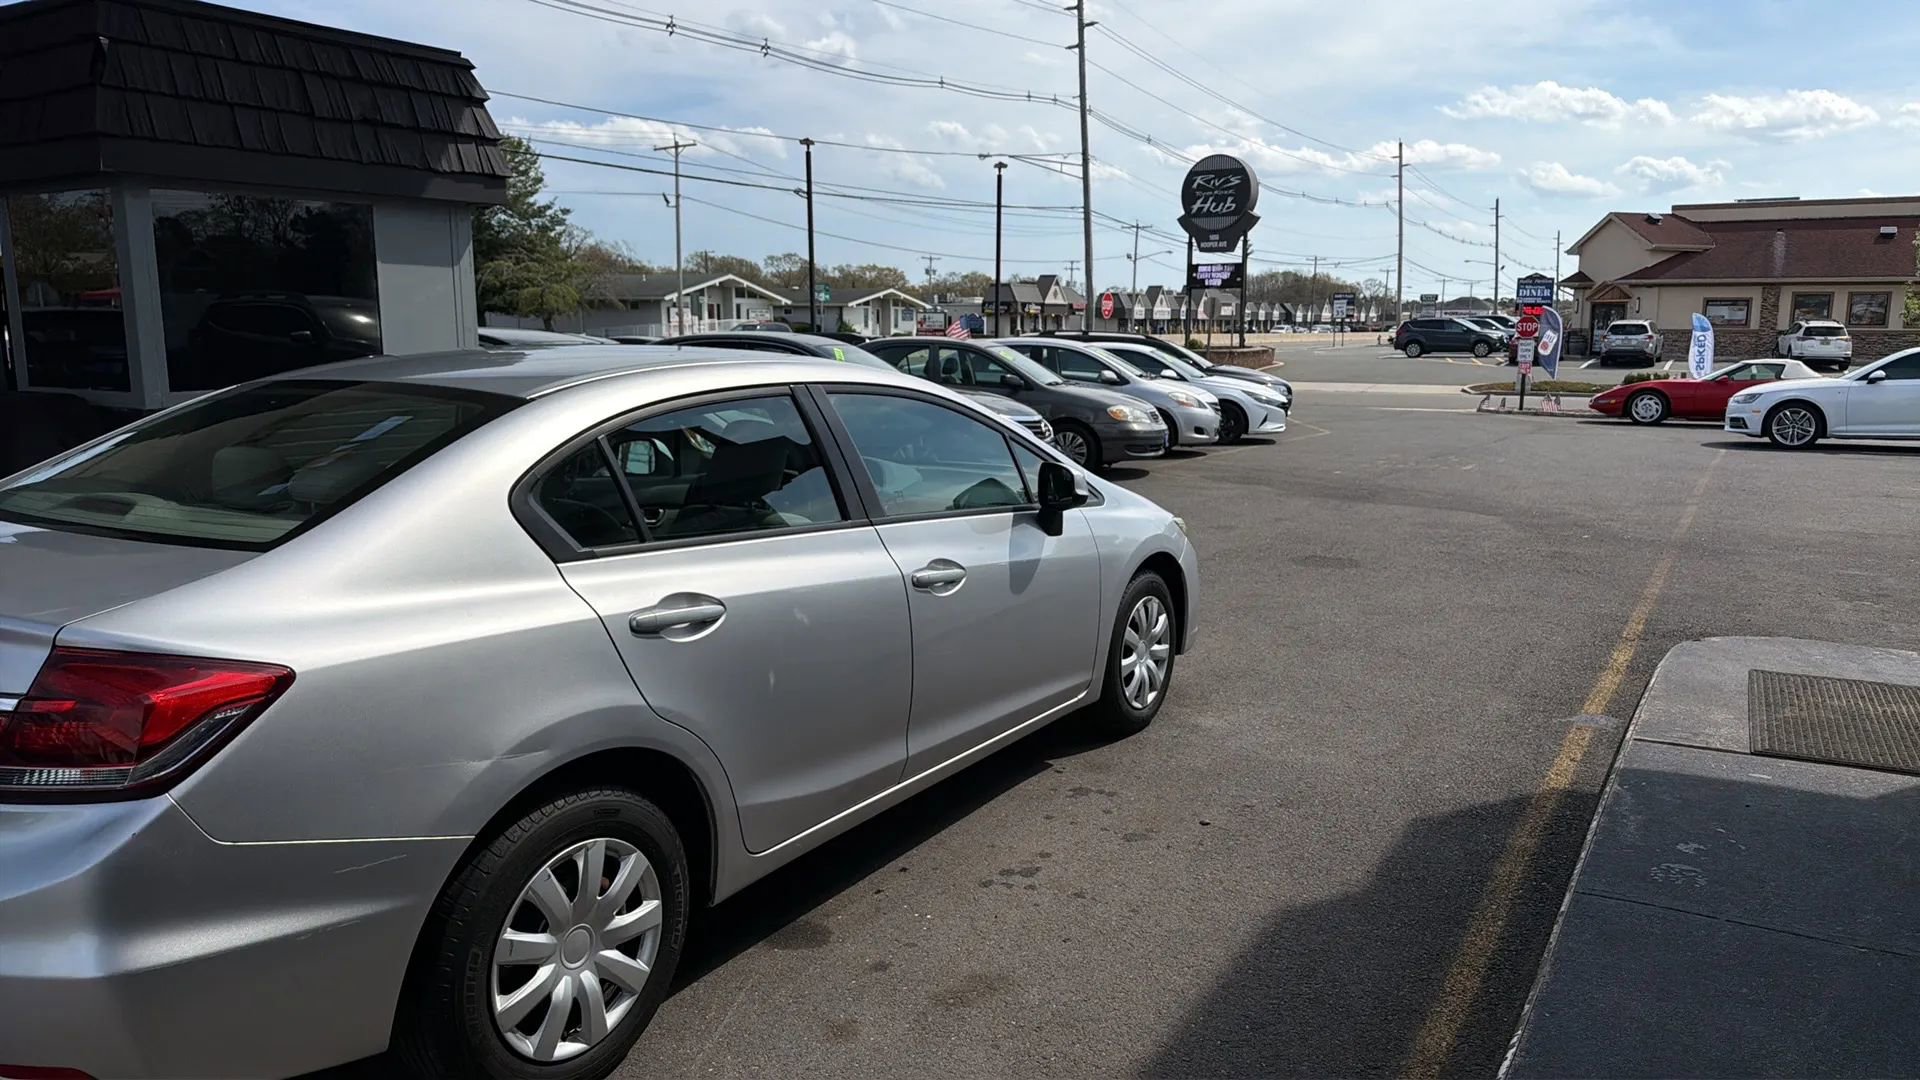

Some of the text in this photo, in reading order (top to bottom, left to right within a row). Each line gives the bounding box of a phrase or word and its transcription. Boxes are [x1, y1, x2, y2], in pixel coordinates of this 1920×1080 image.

[1191, 196, 1236, 214] Hub
[1519, 288, 1551, 297] DINER
[1517, 322, 1538, 332] STOP
